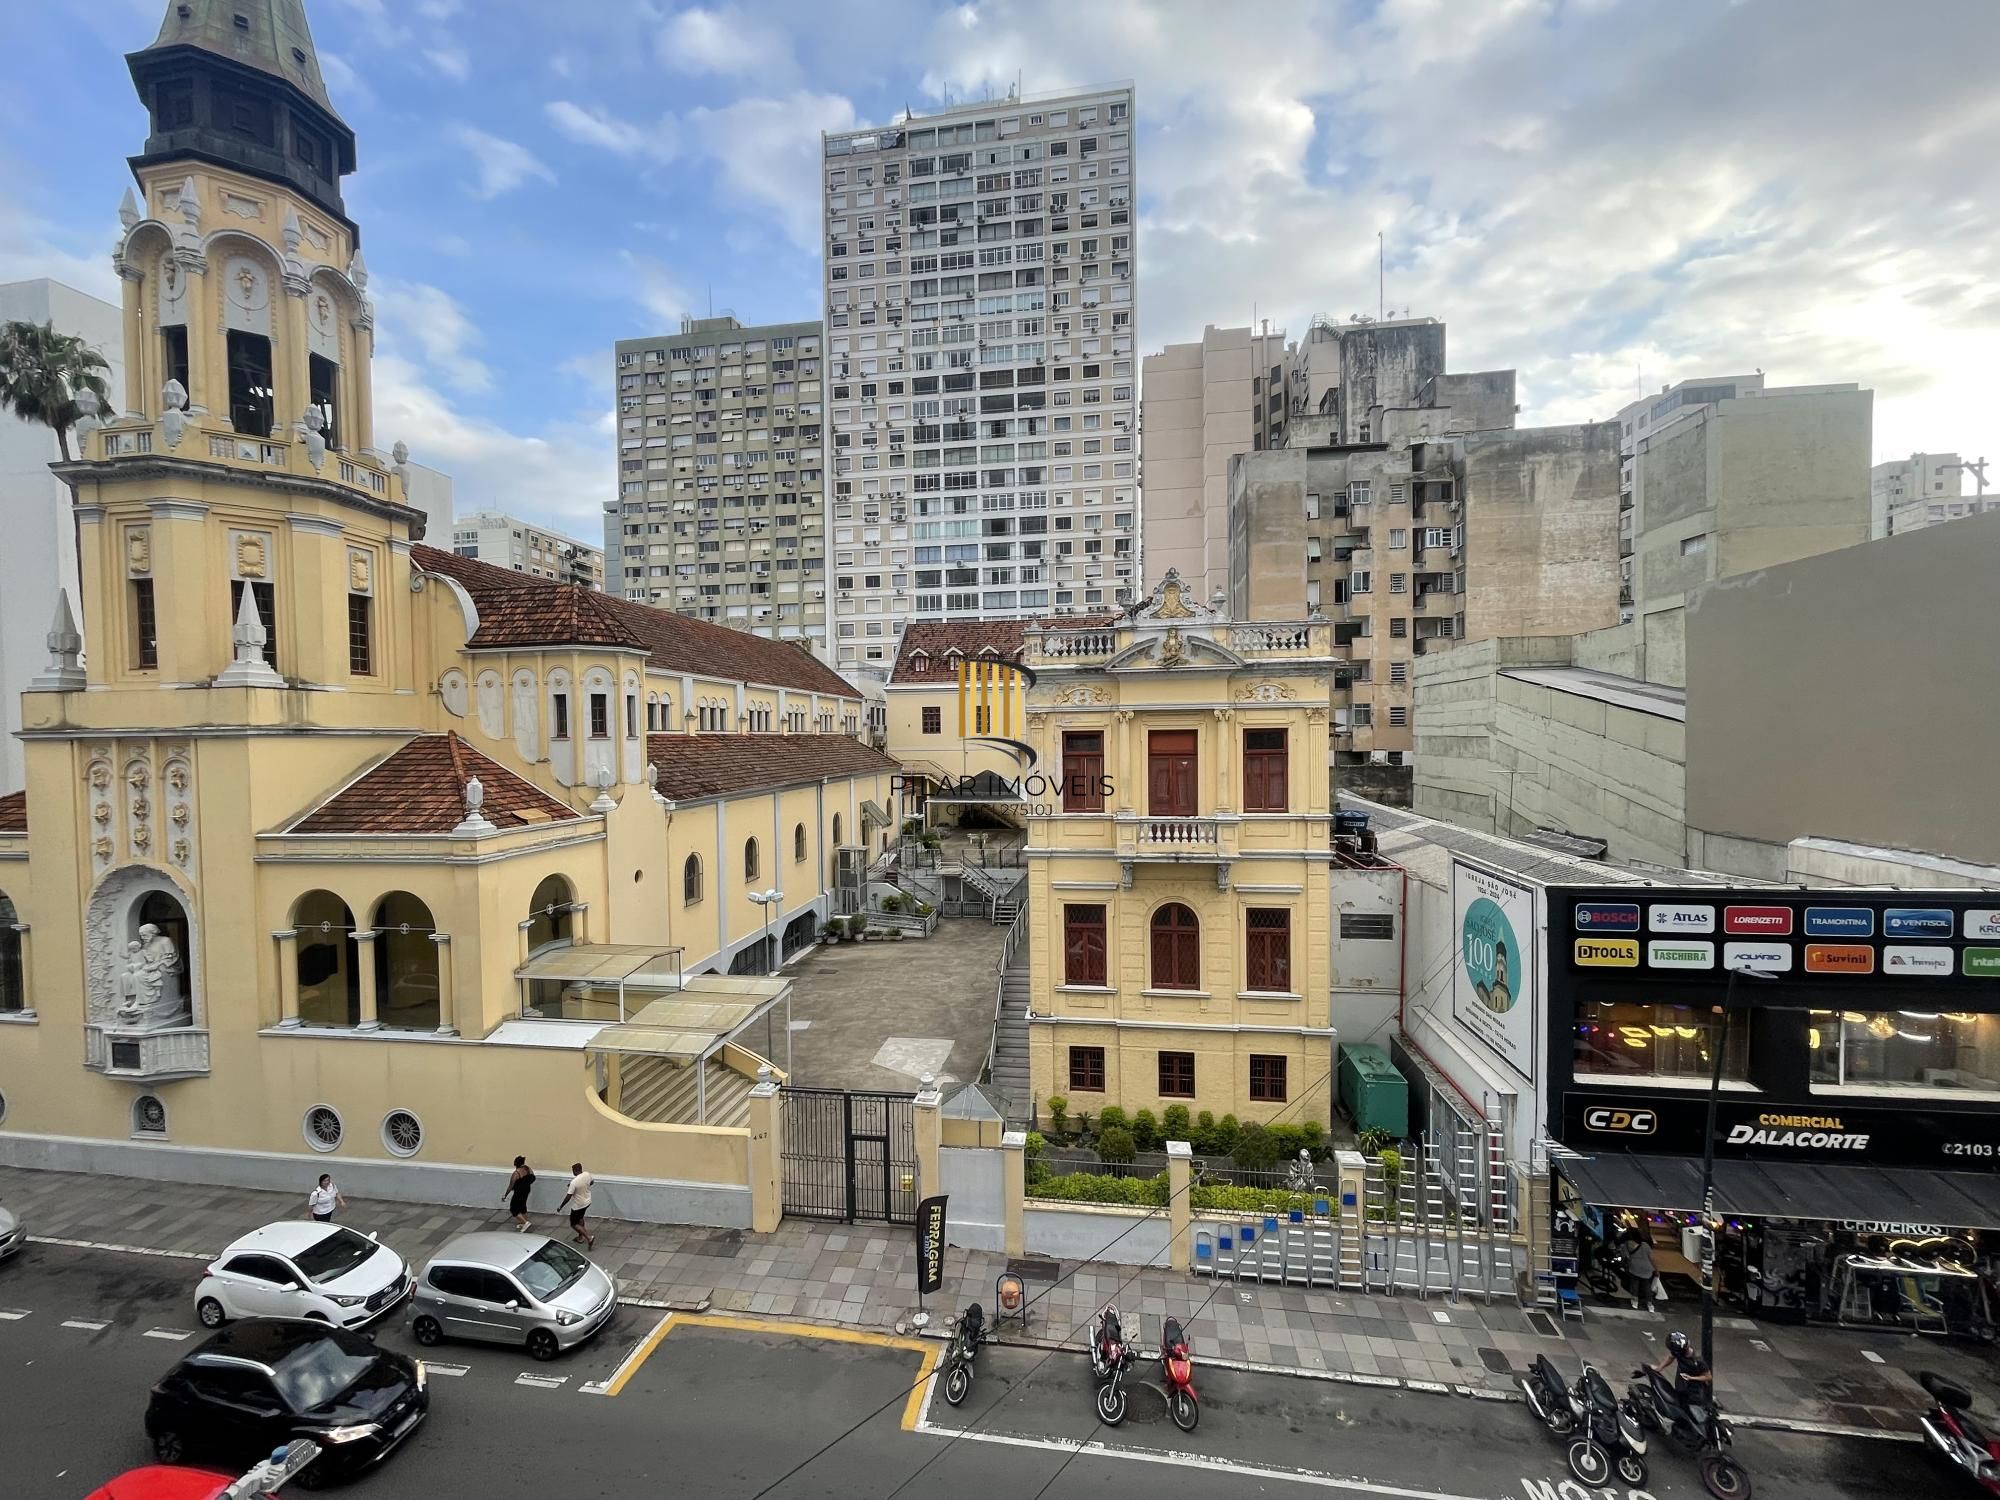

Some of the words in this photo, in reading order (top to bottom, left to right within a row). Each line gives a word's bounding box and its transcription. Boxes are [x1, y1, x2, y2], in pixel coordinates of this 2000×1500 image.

[1465, 871, 1485, 885] IGREJA
[1487, 880, 1499, 892] SÃO
[1591, 912, 1638, 923] BOSCH
[1673, 912, 1708, 923] ATLAS
[1733, 916, 1784, 925] LORENZETTI
[1811, 917, 1868, 926] TRAMONTINA
[1902, 919, 1949, 927] VENTISOL
[1466, 933, 1493, 972] 100
[1652, 948, 1709, 962] TASCHIBRA
[1826, 953, 1867, 964] Suvinil
[1589, 1111, 1653, 1131] CDC
[1759, 1113, 1844, 1130] COMERCIAL
[1727, 1125, 1870, 1150] DALACORTE
[1953, 1143, 1993, 1156] 2103
[928, 1205, 942, 1283] FERRAGEM
